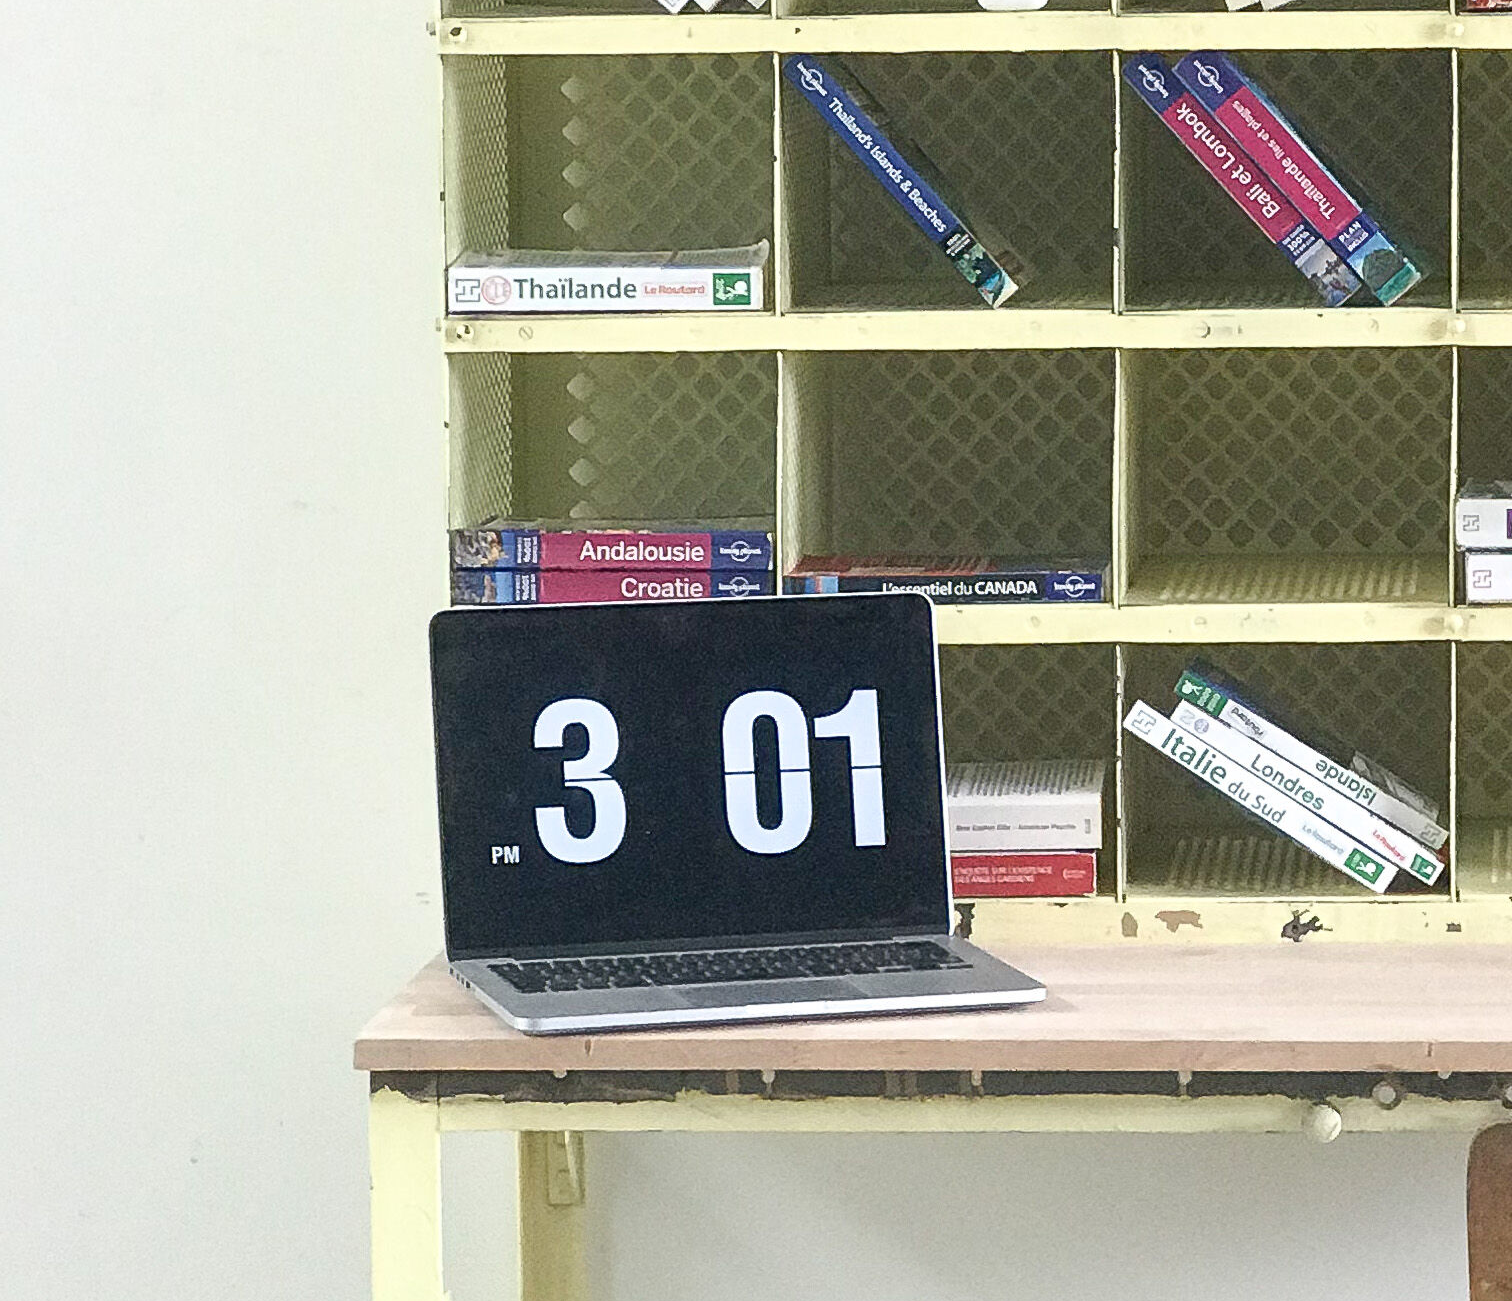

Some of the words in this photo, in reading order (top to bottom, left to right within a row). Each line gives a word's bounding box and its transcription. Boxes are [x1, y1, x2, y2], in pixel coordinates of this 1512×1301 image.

[1231, 100, 1262, 131] plages
[1176, 102, 1236, 170] Lombok
[1256, 128, 1270, 142] et
[828, 96, 874, 150] Thailand's
[869, 145, 904, 184] Islands
[899, 179, 913, 194] &
[907, 188, 947, 233] Beaches
[1230, 164, 1252, 185] et
[1245, 183, 1281, 219] Bali
[1281, 156, 1336, 220] Thaïlande
[513, 277, 638, 300] Thaïlande
[661, 284, 706, 295] Routard
[579, 540, 705, 562] Andalousie
[620, 577, 704, 599] Croatie
[954, 582, 973, 596] du
[974, 581, 1038, 595] CANADA
[534, 699, 627, 864] 3
[722, 689, 887, 855] 01
[1160, 728, 1227, 785] Italie
[1227, 781, 1251, 802] du
[1250, 794, 1287, 824] Sud
[1250, 753, 1325, 811] Londres
[1315, 759, 1377, 806] Islande
[491, 846, 521, 865] PM
